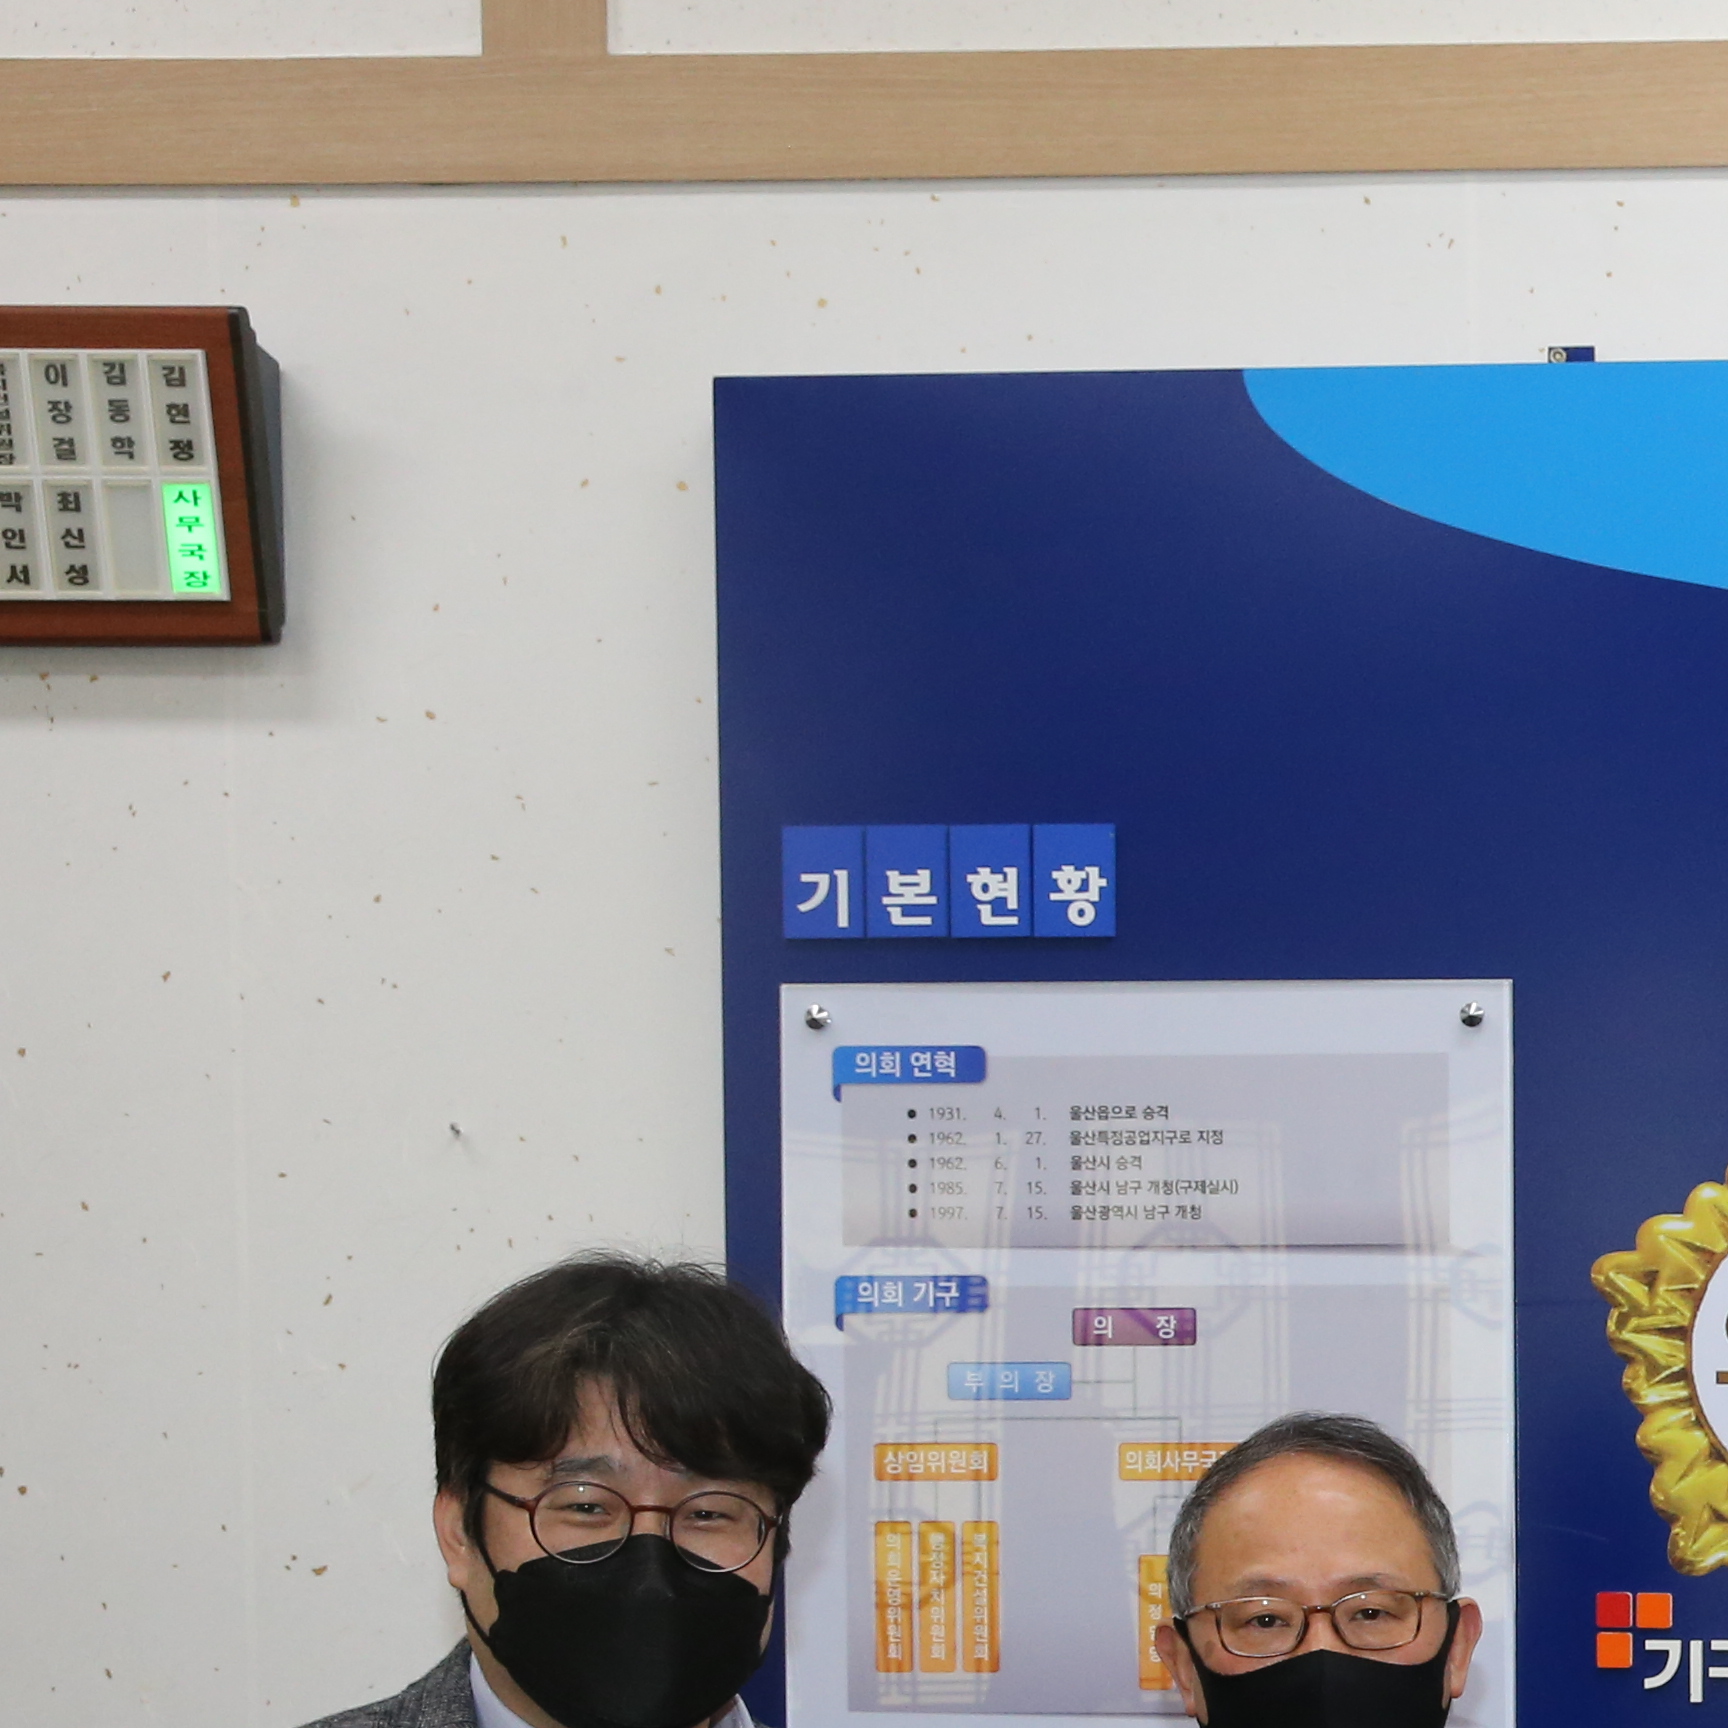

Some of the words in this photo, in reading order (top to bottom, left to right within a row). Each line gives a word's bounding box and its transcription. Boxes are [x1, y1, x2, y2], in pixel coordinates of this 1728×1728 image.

[162, 365, 194, 461] 김현정
[58, 492, 89, 586] 최신성
[173, 490, 211, 587] 사무국장
[797, 865, 1107, 928] 기본현황
[855, 1052, 899, 1078] 의회
[910, 1052, 956, 1078] 연혁
[929, 1107, 966, 1121] 1931.
[1142, 1107, 1169, 1121] 승격
[929, 1131, 966, 1146] 1962.
[1070, 1131, 1192, 1146] 울산특정공업지구로
[1197, 1131, 1223, 1146] 지정
[929, 1156, 967, 1171] 1962.
[1071, 1156, 1110, 1171] 울산시
[1116, 1156, 1142, 1171] 승격
[930, 1181, 967, 1196] 1985.
[1071, 1181, 1110, 1196] 울산시
[1116, 1181, 1142, 1196] 남구
[930, 1205, 967, 1221] 1997.
[1071, 1205, 1138, 1221] 울산광역시
[1143, 1205, 1170, 1221] 남구
[1175, 1205, 1202, 1221] 개청
[858, 1283, 903, 1307] 의회
[913, 1282, 960, 1307] 기구
[883, 1451, 989, 1473] 상임위원회
